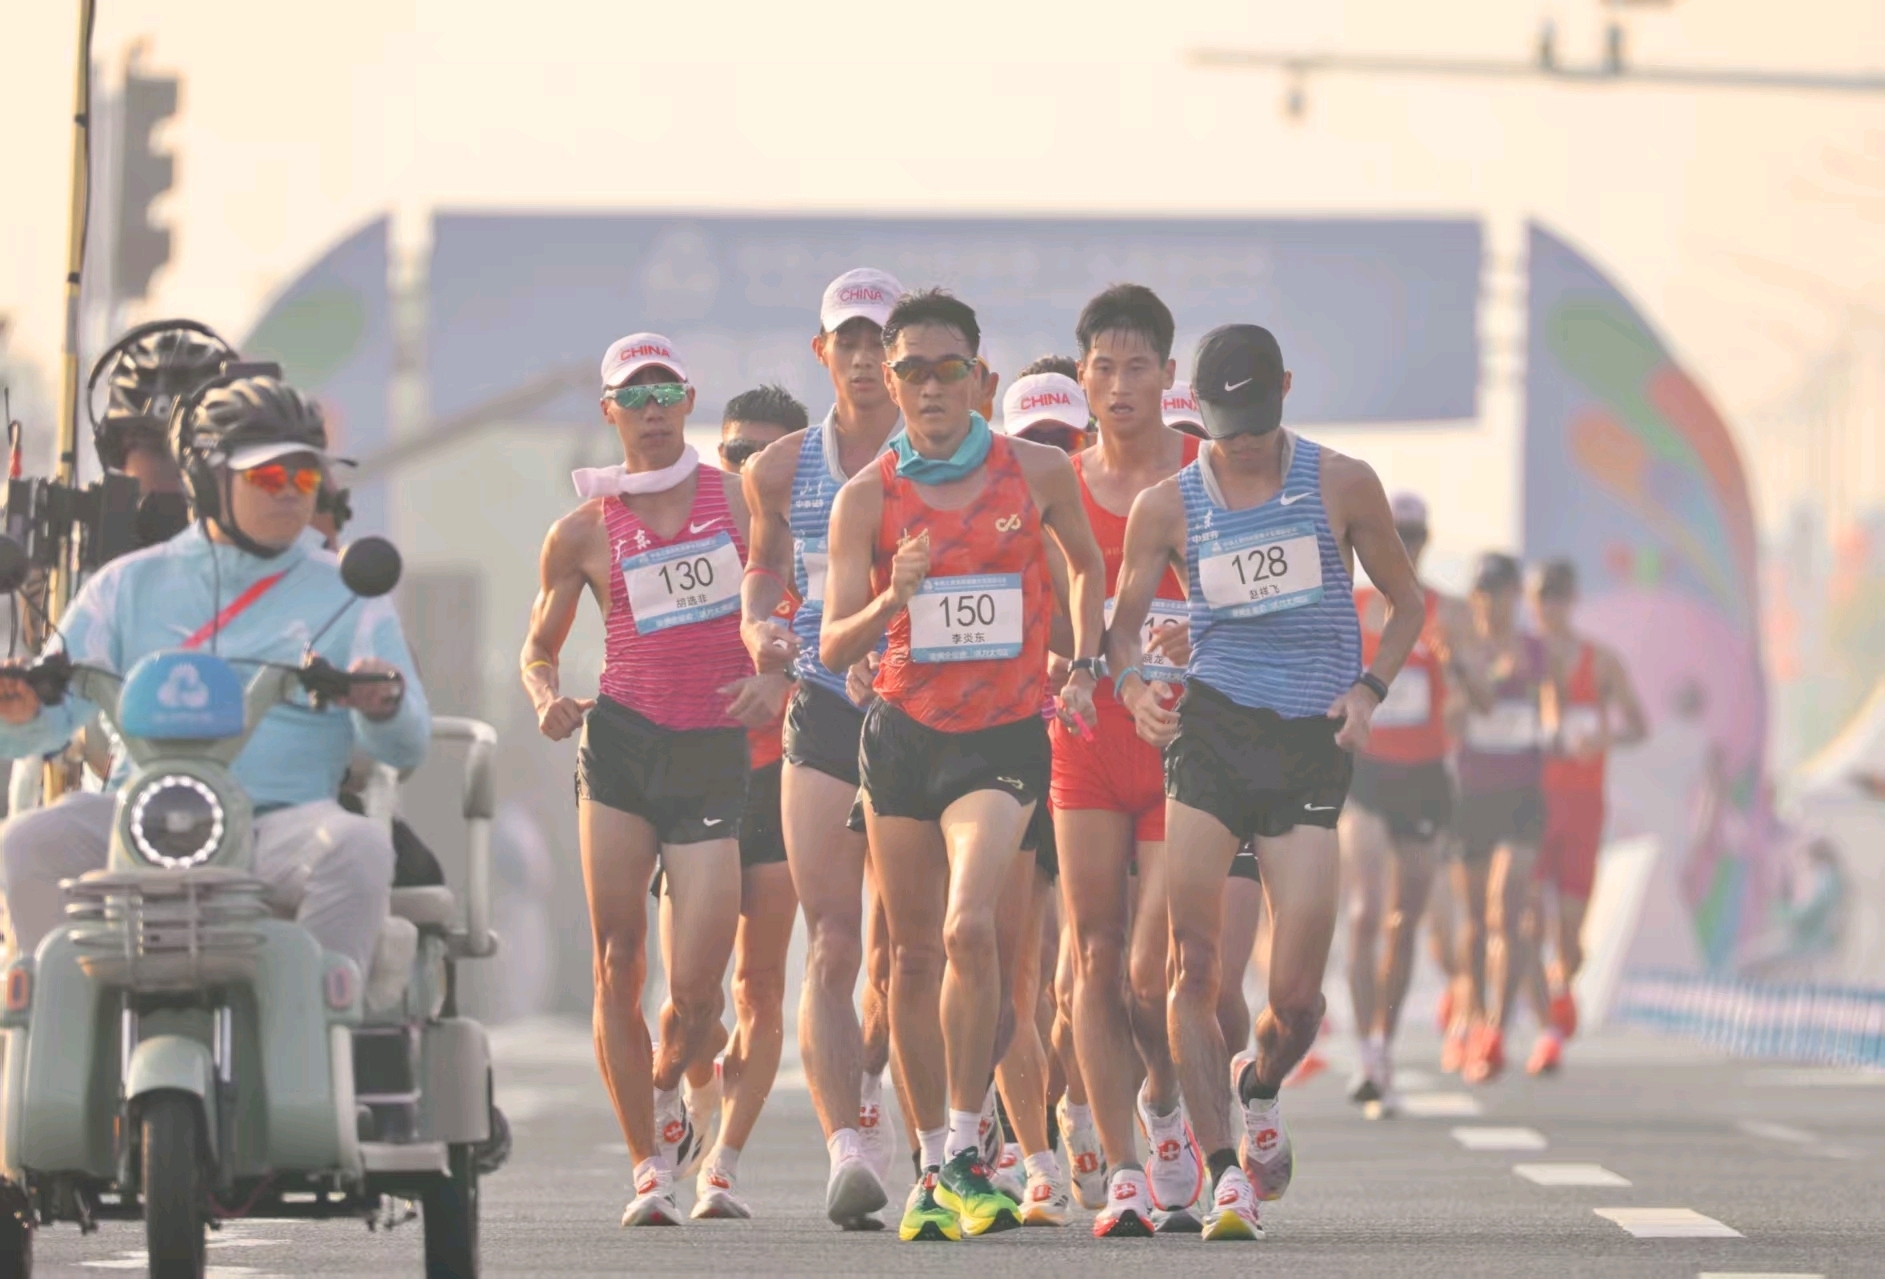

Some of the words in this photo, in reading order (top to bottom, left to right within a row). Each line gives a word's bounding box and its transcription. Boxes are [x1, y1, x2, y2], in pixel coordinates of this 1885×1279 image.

[839, 287, 884, 302] CHINA
[620, 345, 670, 361] CHINA
[1020, 392, 1071, 410] CHINA
[1162, 397, 1199, 411] HIN
[614, 529, 651, 563] 广东
[1231, 546, 1288, 585] 128
[658, 557, 714, 594] 130
[939, 593, 995, 628] 150
[952, 632, 985, 644] 李炎东
